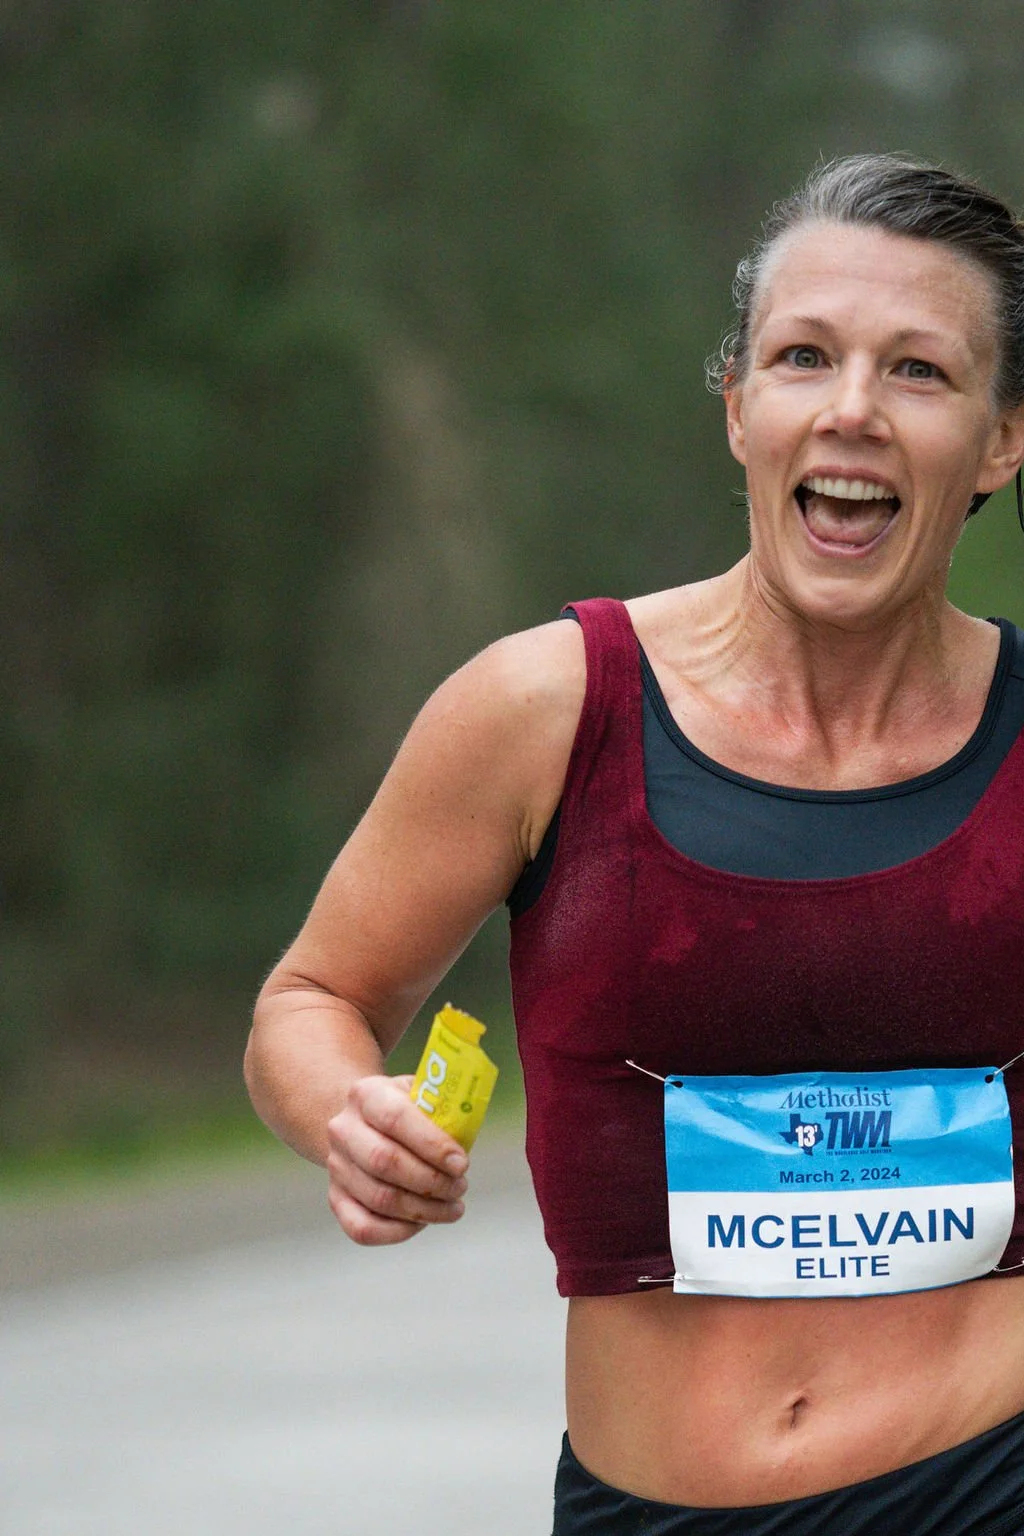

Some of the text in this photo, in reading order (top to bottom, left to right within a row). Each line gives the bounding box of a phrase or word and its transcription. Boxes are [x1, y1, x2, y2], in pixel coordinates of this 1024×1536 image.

[779, 1086, 892, 1109] Methodist
[825, 1110, 892, 1149] TWM
[779, 1166, 901, 1184] March 2, 2024
[707, 1206, 974, 1249] MCELVAIN
[795, 1254, 891, 1279] ELITE
